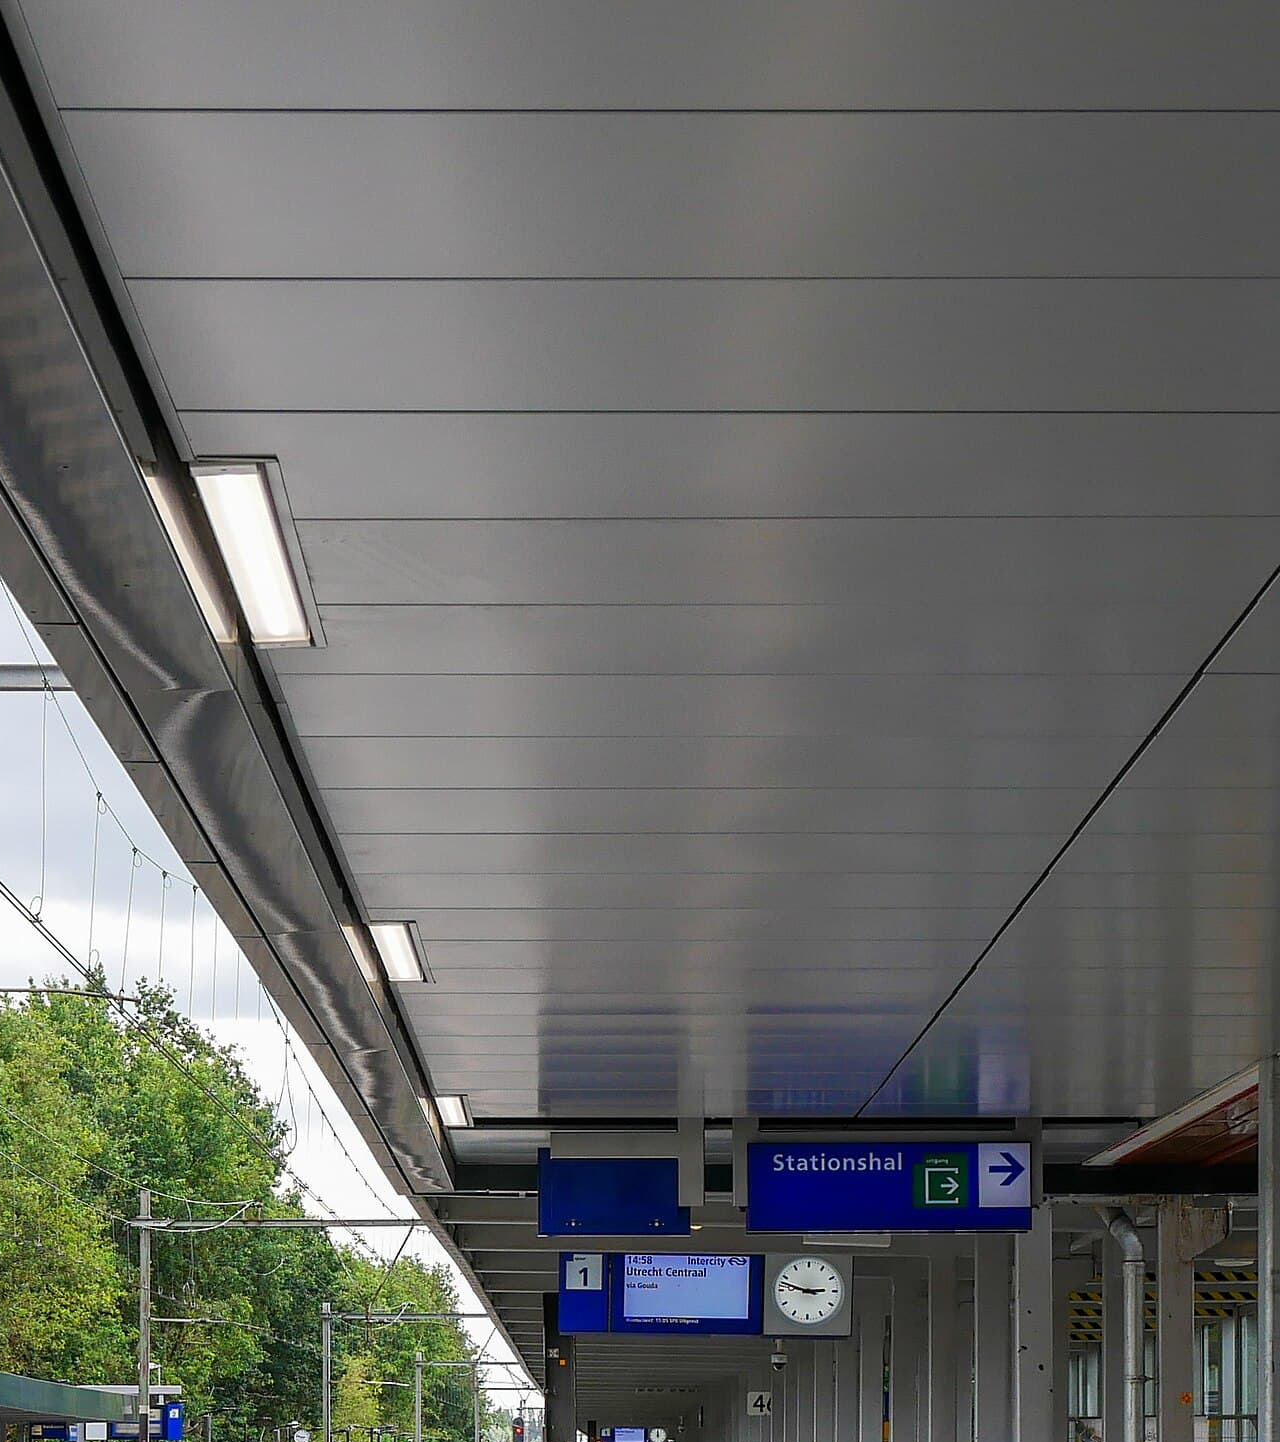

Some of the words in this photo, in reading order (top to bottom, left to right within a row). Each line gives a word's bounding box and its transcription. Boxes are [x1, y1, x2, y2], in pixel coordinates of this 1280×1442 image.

[773, 1152, 902, 1171] Stationshal
[627, 1255, 653, 1265] 14:58
[687, 1256, 726, 1268] Intercity
[578, 1267, 588, 1287] 1
[626, 1267, 663, 1277] Utrecht
[665, 1267, 707, 1278] Centraal
[626, 1281, 636, 1289] via
